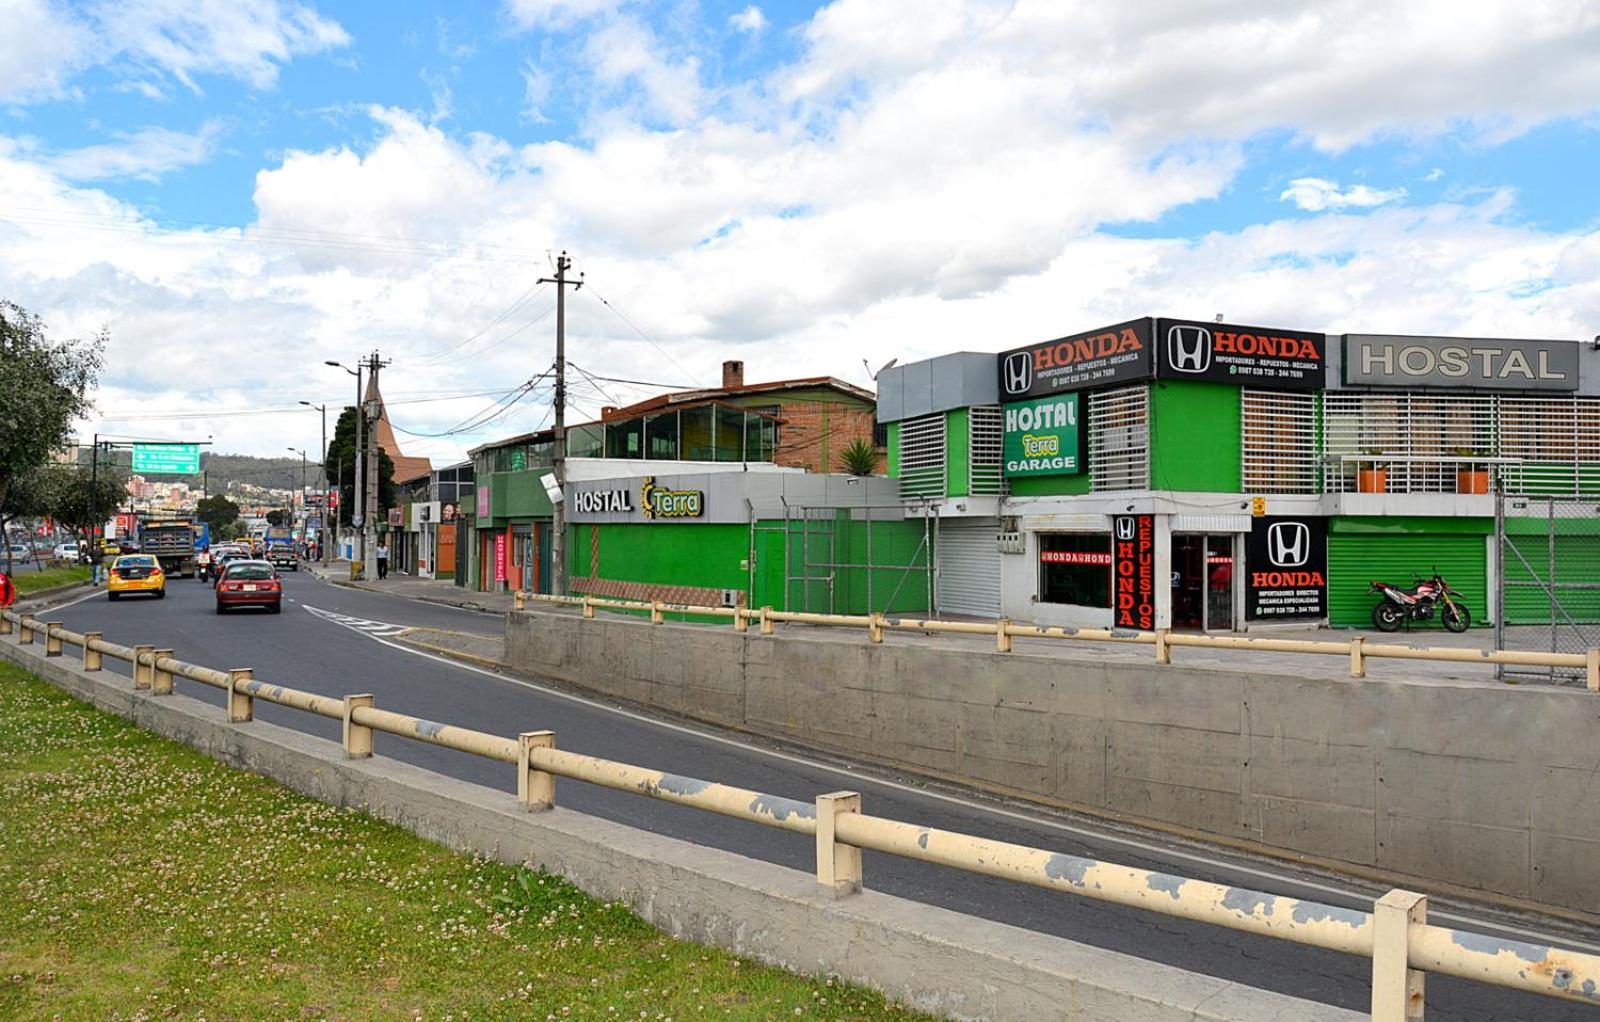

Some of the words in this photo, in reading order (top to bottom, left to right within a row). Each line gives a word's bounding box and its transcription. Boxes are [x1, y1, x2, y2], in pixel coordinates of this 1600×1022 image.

[1033, 328, 1142, 370] HONDA
[1214, 332, 1320, 359] HONDA
[1037, 366, 1072, 379] IMPORTADORES
[1078, 360, 1106, 370] REPUESTOS
[1110, 352, 1138, 364] MECANICA
[1216, 356, 1255, 365] IMPORTADORES
[1260, 359, 1288, 368] REPUESTOS
[1293, 361, 1318, 370] MECANICA
[1361, 344, 1567, 380] HOSTAL
[1006, 401, 1076, 432] HOSTAL
[1024, 436, 1057, 454] Terra
[1007, 456, 1075, 472] GARAGE
[575, 490, 632, 512] HOSTAL
[654, 491, 699, 514] Terra
[1047, 552, 1078, 562] HONDA
[1118, 542, 1134, 625] HONDA
[1138, 516, 1152, 629] REPUESTOS
[1252, 572, 1325, 587] HONDA
